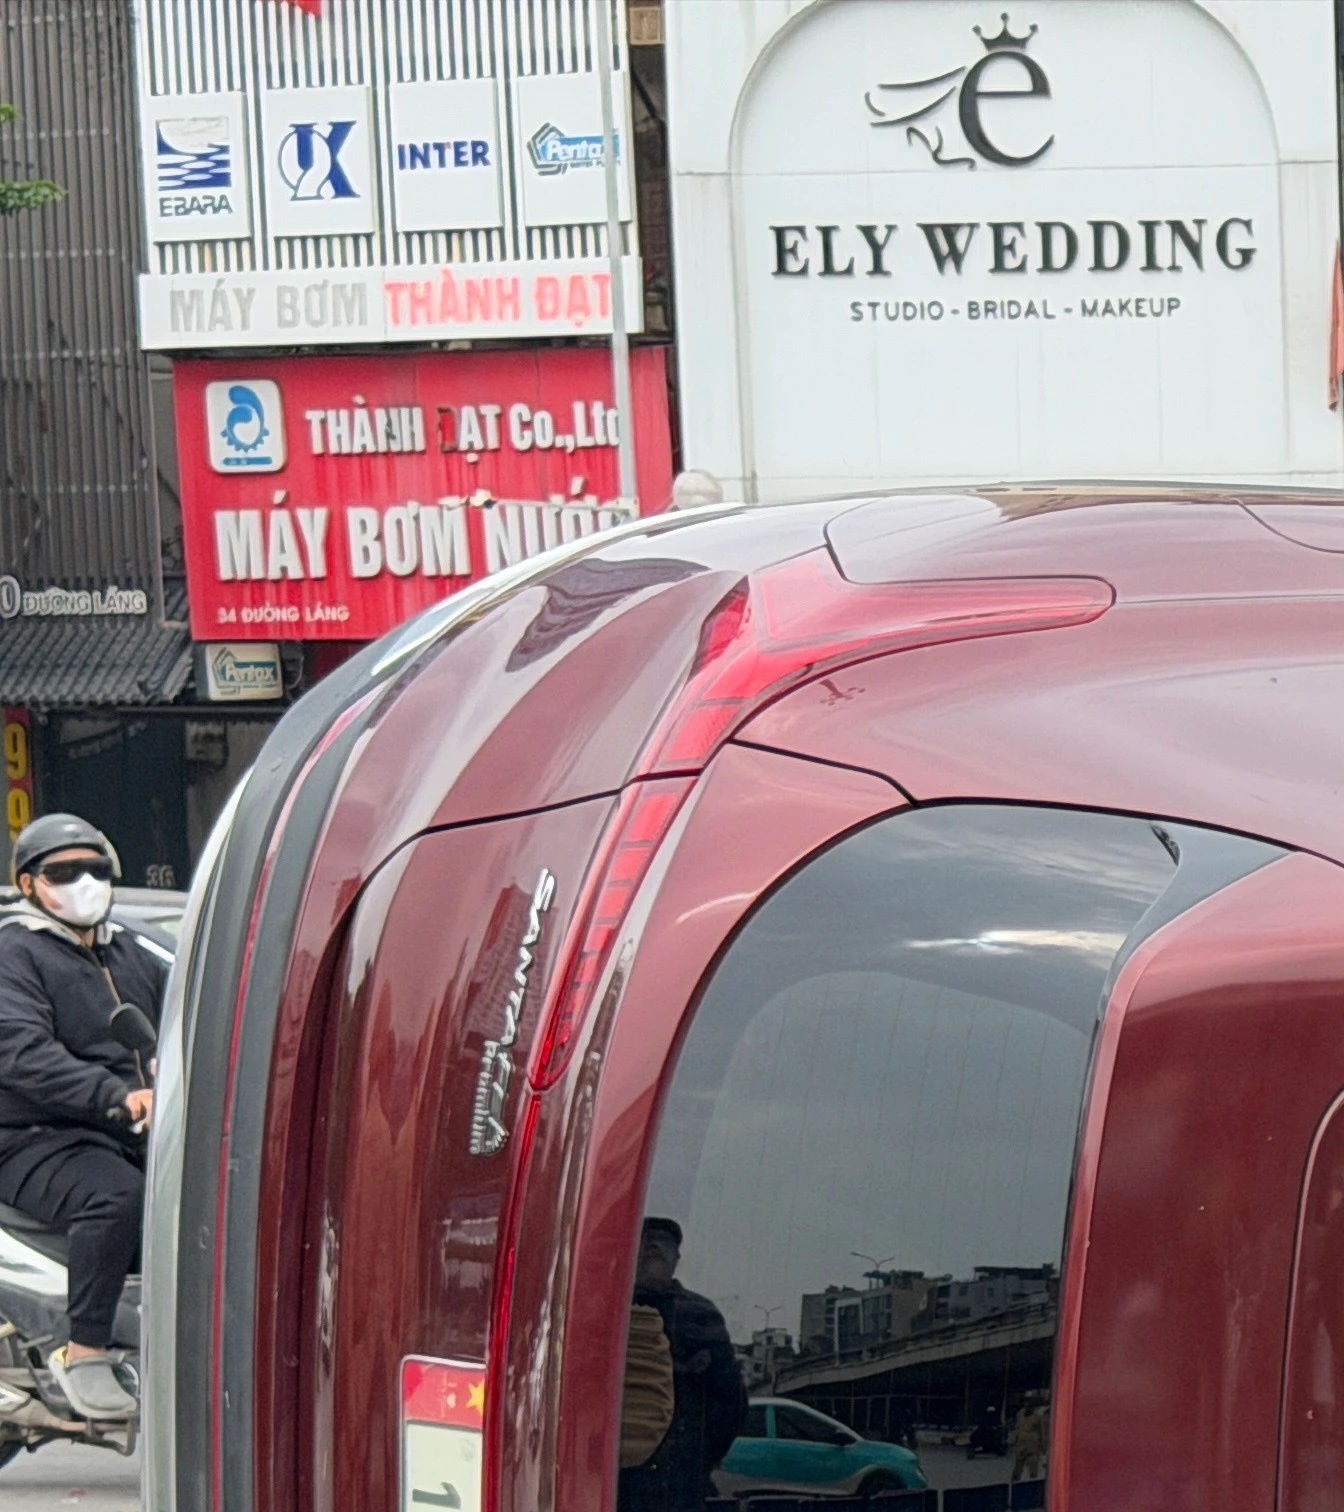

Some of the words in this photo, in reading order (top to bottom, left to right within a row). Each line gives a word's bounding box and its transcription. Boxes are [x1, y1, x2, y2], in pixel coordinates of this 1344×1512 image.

[399, 141, 491, 170] INTER
[546, 139, 613, 161] Penta
[159, 197, 233, 218] EBARA
[769, 223, 897, 278] ELY
[916, 217, 1258, 275] WEDDING
[171, 278, 256, 332] MÁY
[277, 280, 368, 328] BƠM
[385, 268, 519, 325] THÀNH
[535, 274, 613, 327] ĐẠT
[851, 302, 944, 322] STUDIO
[968, 301, 1055, 320] BRIDAL
[1081, 298, 1181, 318] MAKEUP
[305, 395, 425, 455] THÀNH
[214, 489, 327, 581] MÁY
[346, 500, 470, 579] BƠM
[305, 602, 350, 622] LÁNG
